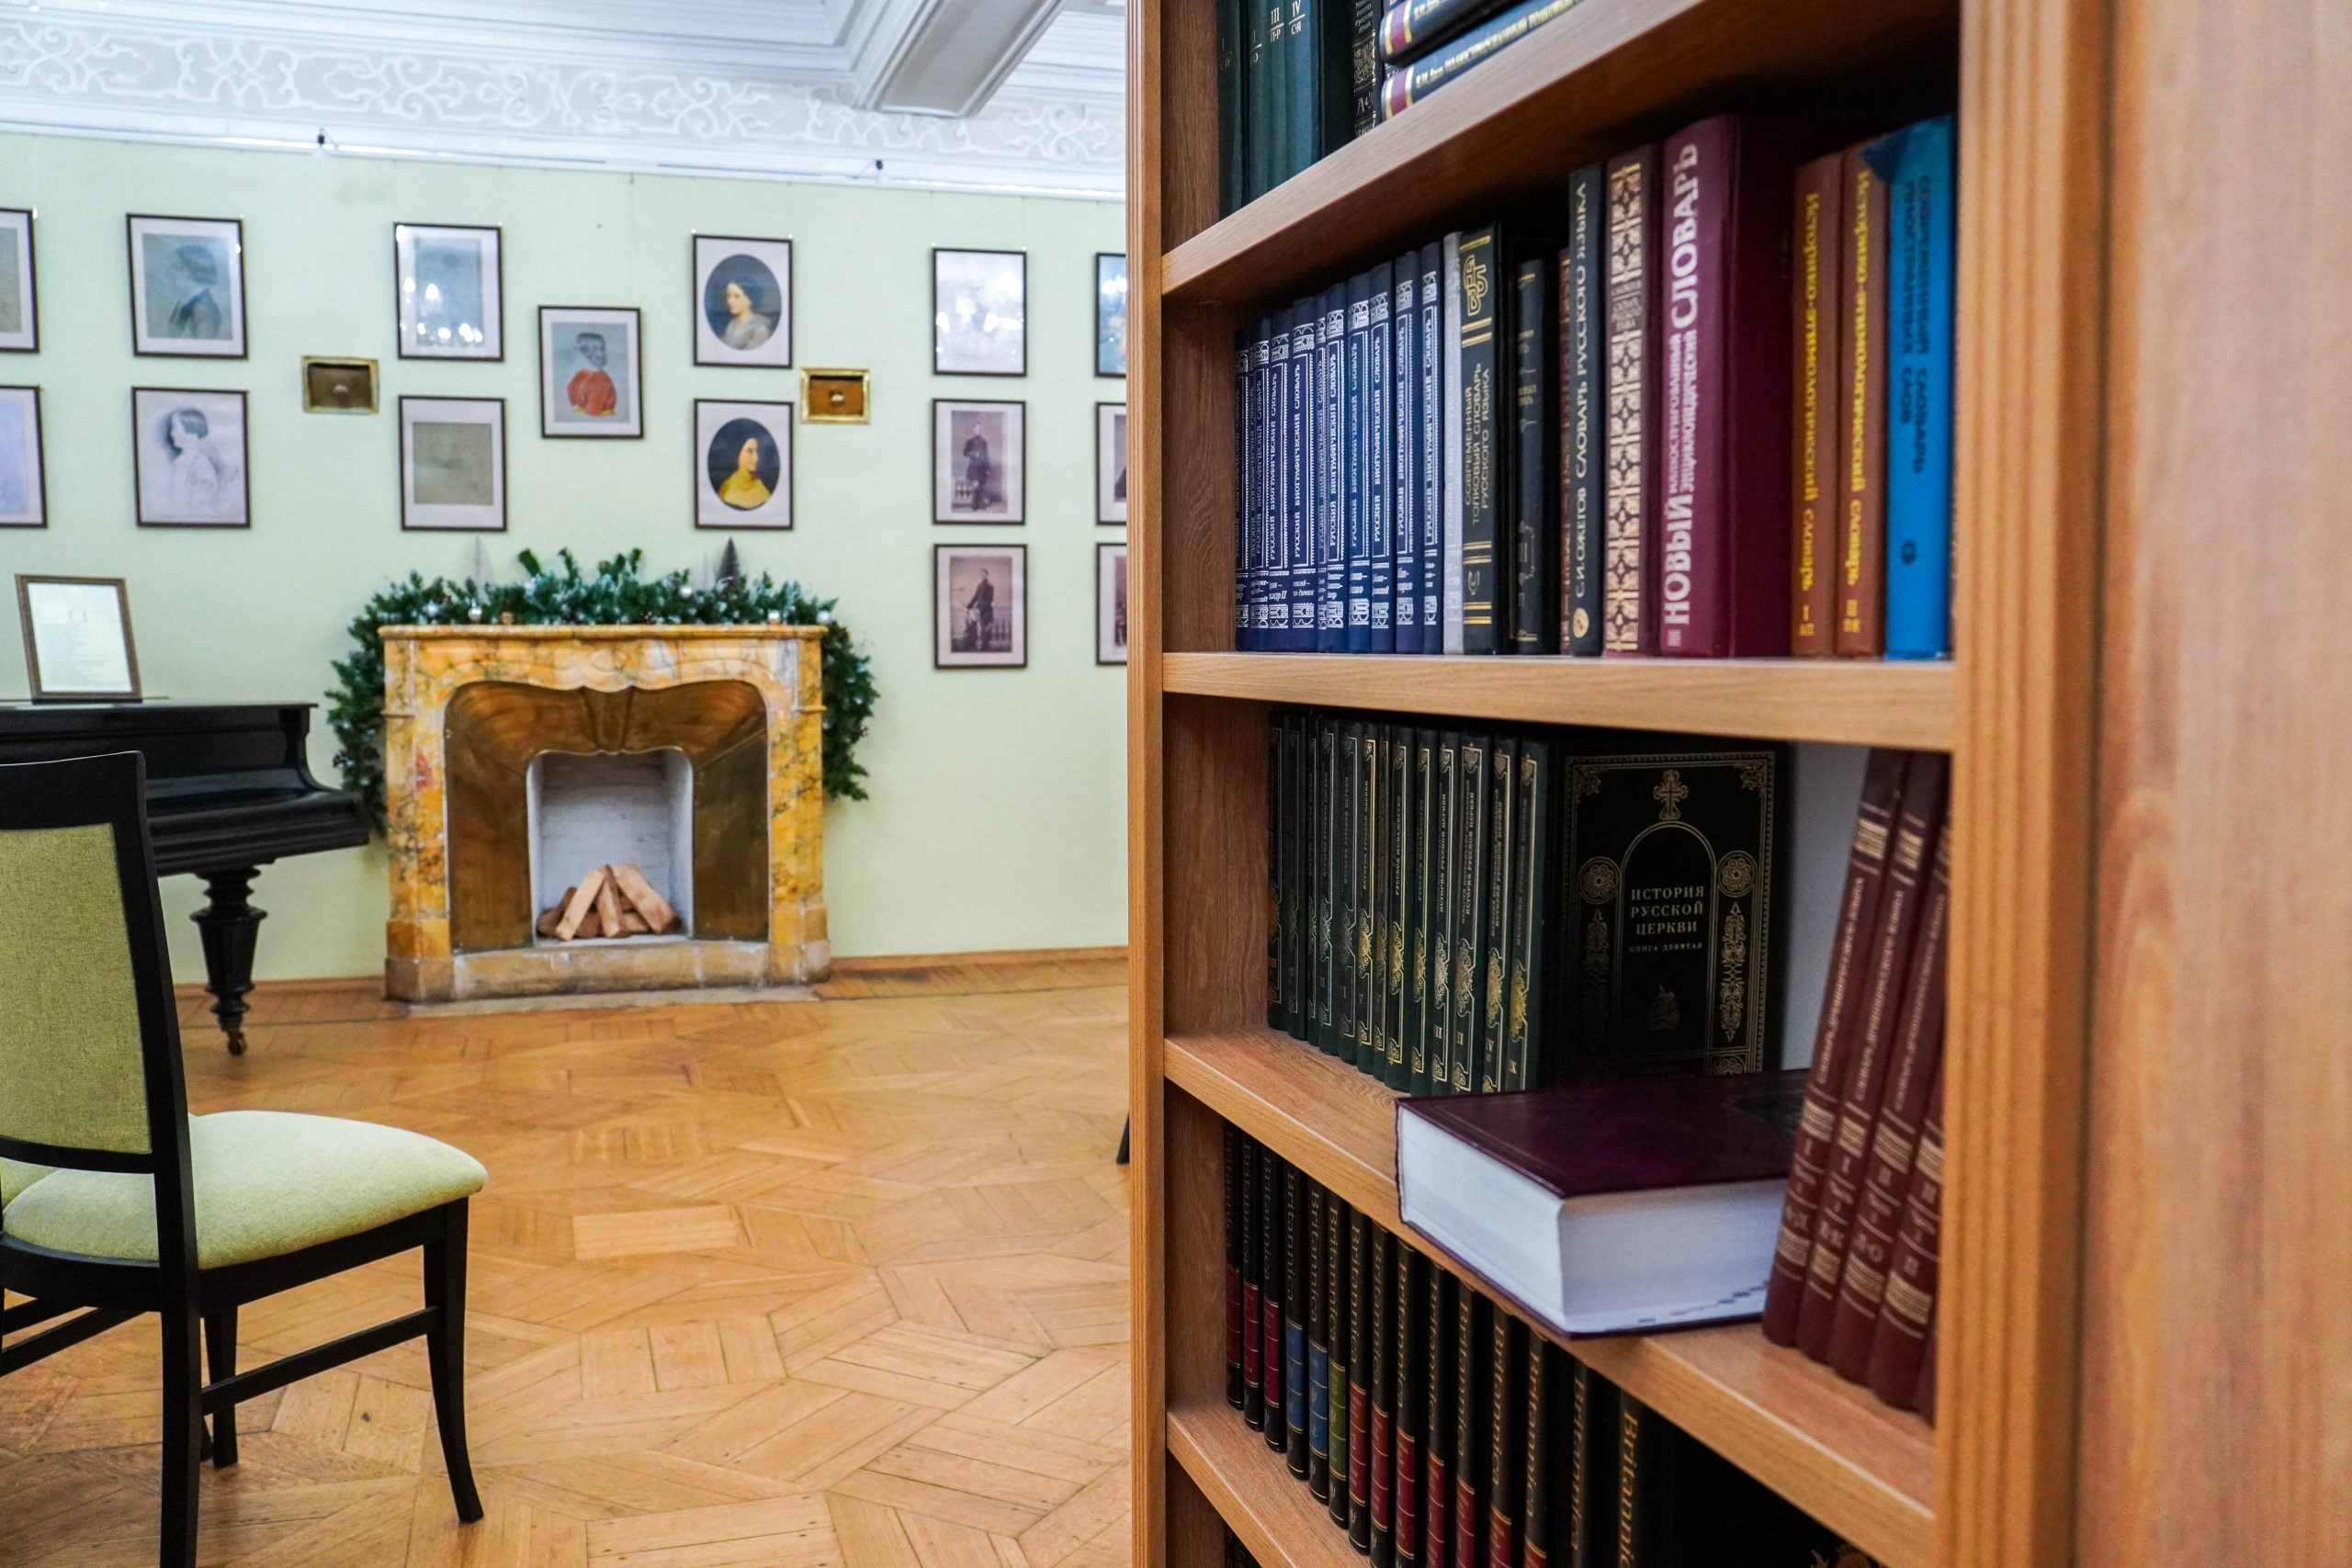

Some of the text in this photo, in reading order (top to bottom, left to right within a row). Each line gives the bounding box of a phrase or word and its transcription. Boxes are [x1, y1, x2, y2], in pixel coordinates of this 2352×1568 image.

[1271, 6, 1280, 25] III
[1291, 20, 1302, 36] С-Я
[1292, 0, 1302, 17] IV
[1576, 183, 1587, 258] ЯЗЫКА
[1670, 143, 1699, 330] СЛОВАРЬ
[1576, 265, 1588, 377] РУССКОГО
[1472, 363, 1481, 525] ТОЛКОВЫЙ СЛОВАРЬ
[1481, 367, 1489, 509] РУССКОГО ЯЗЫКА
[1576, 380, 1588, 478] СЛОВАРЬ
[1668, 333, 1681, 494] ИЛЛЮСТРИРОВАННЫЙ
[1680, 330, 1699, 494] ЭНЦИКЛОПЕДИЧЕСКИЙ
[1900, 365, 1913, 425] СЛОВ
[1913, 367, 1928, 474] СЛОВАРЬ
[1664, 494, 1694, 626] НОВЫЙ
[1799, 508, 1815, 592] словарь
[1844, 499, 1862, 586] словарь
[1629, 942, 1702, 953] КНИГА ДЕВЯТАЯ
[1631, 886, 1704, 900] ИСТОРИЯ
[1631, 900, 1702, 919] РУССКОЙ
[1636, 920, 1698, 937] ЦЕРКВИ
[1243, 1142, 1251, 1265] Britannica
[1263, 1156, 1272, 1280] Britannica
[1286, 1173, 1296, 1302] Britannica
[1310, 1189, 1320, 1323] Britannica
[1329, 1205, 1339, 1342] Britannica
[1351, 1223, 1360, 1365] Britannica
[1373, 1241, 1383, 1385] Britannica
[1397, 1261, 1407, 1408] Britannica
[1429, 1280, 1438, 1430] Britannica
[1458, 1300, 1469, 1457] Britannica
[1492, 1324, 1505, 1486] Britannica
[1526, 1350, 1540, 1518] Britannica
[1571, 1376, 1585, 1551] Britannica
